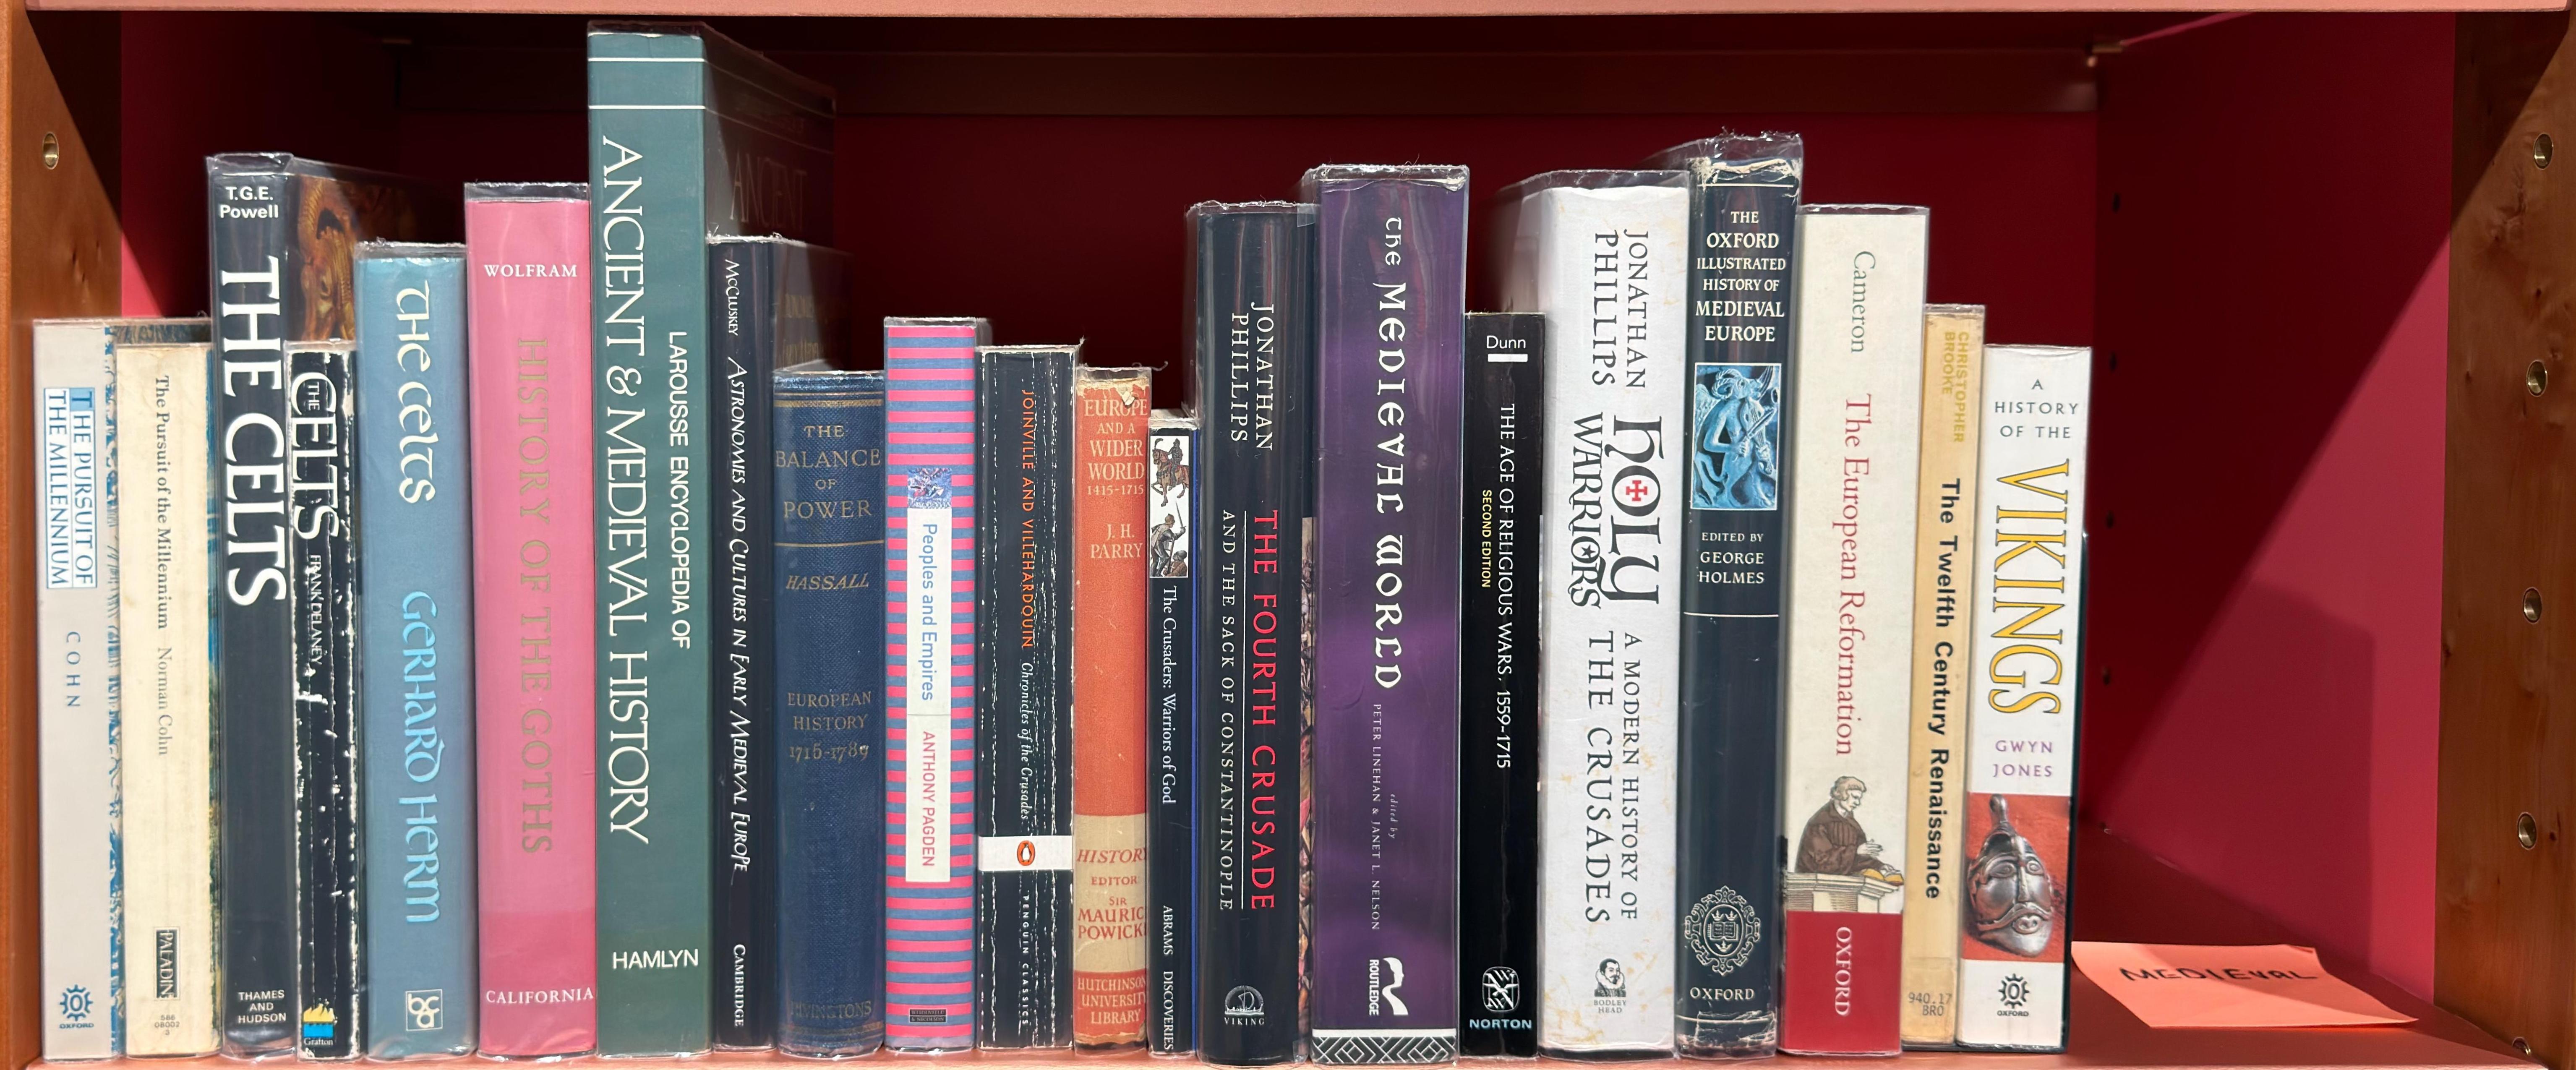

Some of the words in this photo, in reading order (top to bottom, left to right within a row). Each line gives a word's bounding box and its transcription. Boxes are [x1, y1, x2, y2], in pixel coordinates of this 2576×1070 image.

[220, 204, 279, 219] Powell
[225, 187, 273, 201] T.G.E.
[1731, 211, 1759, 223] THE
[603, 135, 645, 356] ANCIENT
[1707, 233, 1779, 248] OXFORD
[1697, 258, 1785, 270] ILLUSTRATED
[1703, 279, 1761, 291] HISTORY
[1764, 279, 1779, 291] OF
[1696, 301, 1784, 317] MEDIEVAL
[1851, 251, 1876, 354] Cameron
[221, 255, 282, 397] THE
[1487, 336, 1526, 349] Dunn
[1705, 326, 1775, 342] EUROPE
[606, 365, 642, 397] &
[1231, 313, 1249, 442] PHILLIPS
[1251, 302, 1274, 450] JONATHAN
[1942, 331, 1956, 394] BROOKE
[156, 375, 169, 407] The
[306, 381, 320, 410] THE
[669, 331, 688, 446] LAROUSSE
[1953, 331, 1969, 442] CHRISTOPHER
[2031, 379, 2043, 390] A
[48, 390, 67, 435] THE
[72, 391, 92, 443] THE
[1096, 423, 1124, 434] AND
[1127, 423, 1135, 433] A
[1501, 404, 1515, 440] THE
[1845, 393, 1872, 448] The
[1995, 402, 2078, 414] HISTORY
[157, 412, 170, 472] Pursuit
[518, 339, 550, 523] HISTORY
[804, 425, 845, 438] THE
[1022, 390, 1034, 470] JOINVILLE
[1090, 440, 1143, 457] WIDER
[2000, 425, 2023, 438] OF
[2035, 426, 2071, 438] THE
[291, 372, 340, 540] CELTS
[776, 449, 880, 467] BALANCE
[1088, 463, 1145, 480] WORLD
[1500, 445, 1515, 483] AGE
[74, 453, 93, 548] PURSUIT
[158, 478, 171, 496] of
[815, 479, 837, 490] OF
[1023, 477, 1034, 511] AND
[1087, 485, 1144, 496] 1415-1715
[1499, 488, 1514, 513] OF
[1940, 478, 1960, 524] The
[49, 443, 69, 584] MILLENNIUM
[159, 498, 171, 523] the
[225, 413, 286, 607] CELTS
[606, 408, 648, 636] MEDIEVAL
[784, 500, 872, 519] POWER
[1223, 509, 1235, 553] AND
[1482, 489, 1492, 538] SECOND
[1568, 412, 1602, 609] WARRIORS
[1832, 457, 1869, 581] European
[670, 457, 690, 615] ENCYCLOPEDIA
[1091, 543, 1143, 559] PARRY
[1107, 524, 1115, 539] J.
[1121, 524, 1135, 538] H.
[1254, 510, 1278, 574] THE
[1702, 532, 1745, 542] EDITED
[1750, 533, 1763, 542] BY
[76, 555, 93, 584] OF
[520, 539, 551, 593] OF
[919, 524, 938, 588] Peoples
[1482, 541, 1491, 587] EDITION
[1498, 519, 1514, 616] RELIGIOUS
[1699, 571, 1764, 584] HOLMES
[1700, 552, 1764, 564] GEORGE
[158, 529, 172, 629] Millennium
[310, 555, 324, 601] FRANK
[786, 572, 869, 590] HASSALL
[1022, 519, 1034, 647] VILLEHARDOUIN
[1164, 585, 1176, 613] The
[1223, 564, 1235, 606] THE
[1936, 535, 1958, 628] Twelfth
[1988, 458, 2070, 714] VIKINGS
[922, 595, 937, 625] and
[311, 603, 322, 665] DELANEY
[521, 607, 551, 692] THE
[671, 619, 691, 649] OF
[1163, 618, 1176, 688] Crusaders:
[1222, 617, 1234, 667] SACK
[1498, 621, 1513, 681] WARS,
[1624, 632, 1642, 649] A
[66, 631, 81, 707] COHN
[158, 647, 172, 710] Norman
[918, 632, 937, 700] Empires
[1253, 595, 1277, 725] FOURTH
[1588, 630, 1614, 710] THE
[1836, 590, 1865, 755] Reformation
[788, 691, 872, 707] EUROPEAN
[1020, 662, 1033, 724] Chronicles
[1222, 677, 1234, 703] OF
[1928, 641, 1953, 735] Century
[793, 715, 868, 730] HISTORY
[1162, 693, 1176, 751] Warriors
[1373, 704, 1381, 741] PETER
[1497, 690, 1511, 769] 1559-1715
[1623, 659, 1640, 765] MODERN
[157, 714, 173, 756] Cohn
[608, 651, 649, 844] HISTORY
[790, 741, 869, 762] 1715-1789
[1017, 727, 1032, 742] of
[1021, 745, 1033, 761] the
[1995, 739, 2053, 754] GWYN
[521, 709, 553, 853] GOTHS
[923, 731, 935, 802] ANTHONY
[1163, 755, 1176, 771] of
[1373, 746, 1381, 801] LINEHAN
[1993, 763, 2053, 778] JONES
[1020, 767, 1033, 820] Crusades
[1162, 773, 1176, 804] God
[1390, 794, 1398, 822] edited
[1220, 712, 1234, 910] CONSTANTINOPLE
[1251, 745, 1276, 909] CRUSADE
[1388, 827, 1398, 838] by
[1585, 727, 1614, 922] CRUSADES
[1622, 777, 1639, 882] HISTORY
[1926, 749, 1949, 899] Renaissance
[922, 808, 935, 866] PAGDEN
[1372, 821, 1381, 859] JANET
[1091, 876, 1137, 885] EDITOR
[1621, 892, 1637, 919] OF
[1163, 905, 1173, 955] ABRAMS
[160, 932, 173, 997] PALADIN
[734, 944, 746, 1027] CAMBRIDGE
[2119, 967, 2319, 981] MEDIEVAL
[238, 989, 284, 1001] THAMES
[249, 1002, 274, 1012] AND
[1369, 959, 1379, 1016] ROUTLEDGE
[1690, 987, 1755, 1000] OXFORD
[1908, 992, 1952, 1004] 940.17
[238, 1013, 287, 1023] HUDSON
[1091, 1010, 1141, 1024] LIBRARY
[1164, 971, 1174, 1050] DISCOVERIES
[1469, 1019, 1532, 1029] NORTON
[1922, 1005, 1944, 1016] BRO
